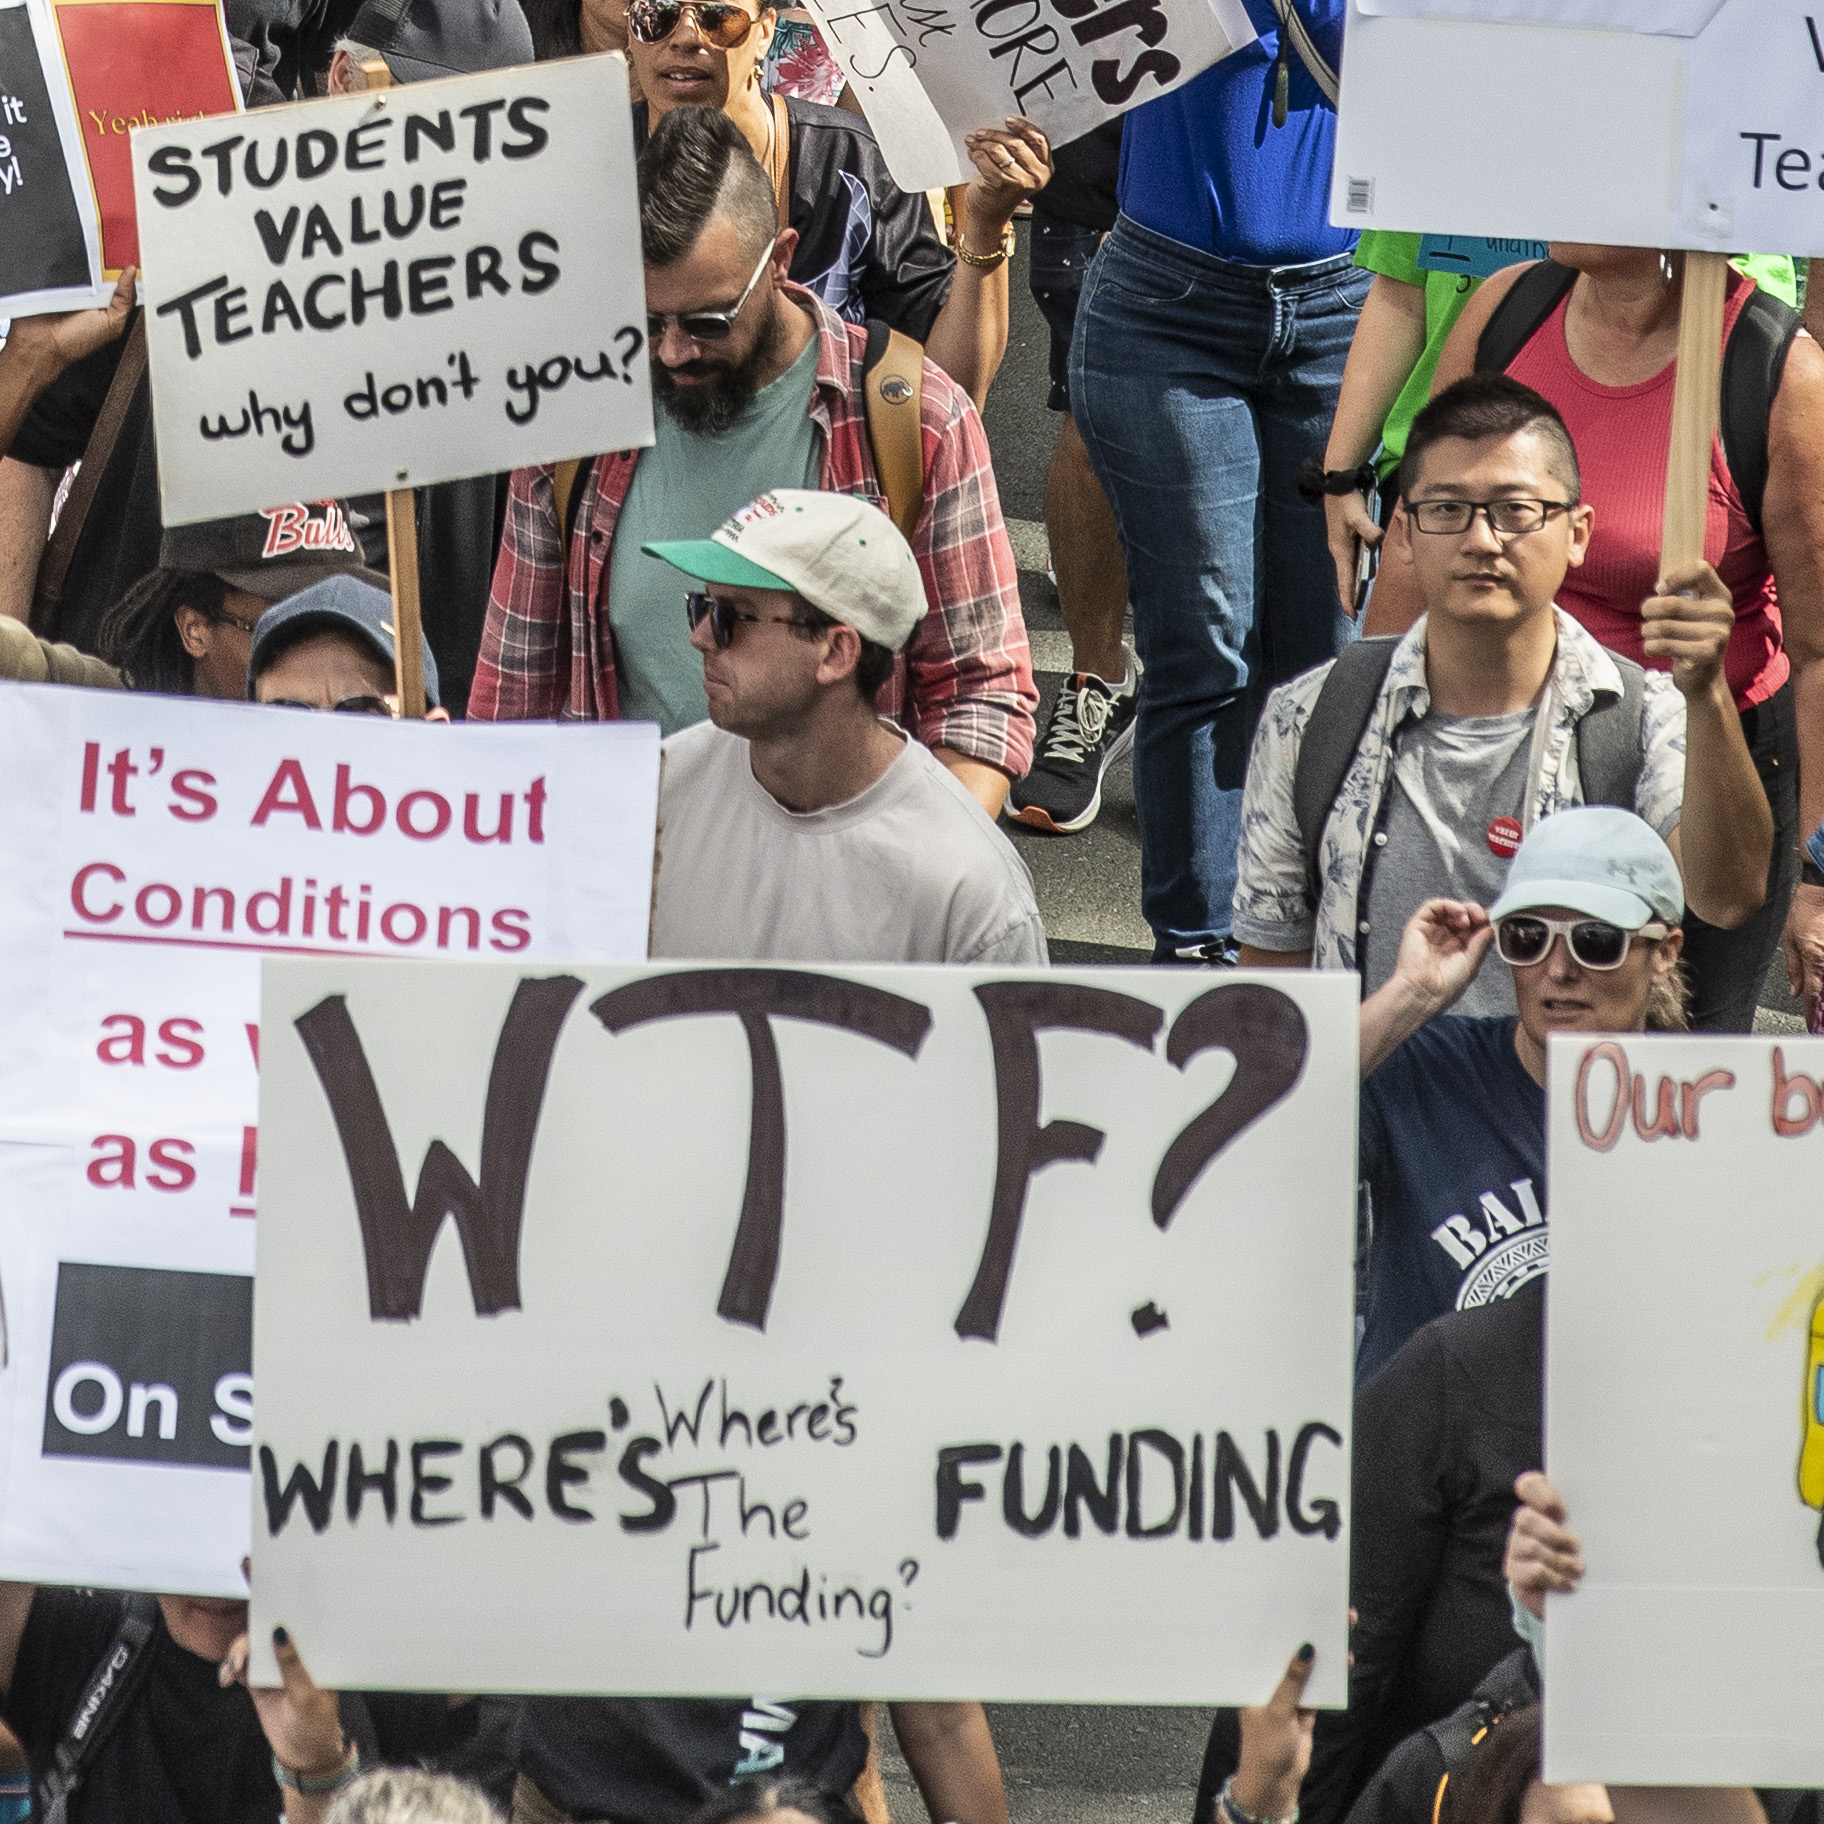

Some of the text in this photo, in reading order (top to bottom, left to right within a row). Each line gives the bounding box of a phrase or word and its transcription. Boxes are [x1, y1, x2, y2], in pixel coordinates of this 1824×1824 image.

[148, 96, 551, 208] STUDENTS
[254, 179, 467, 265] VALUE
[158, 231, 562, 359] TEACHERS
[200, 326, 645, 455] why don't you?
[293, 967, 1308, 1345] WTF?
[262, 1397, 675, 1536] WHERE'S
[655, 1379, 858, 1449] Where's
[666, 1471, 811, 1542] The
[935, 1422, 1343, 1541] FUNDING
[685, 1546, 920, 1659] Funding?
